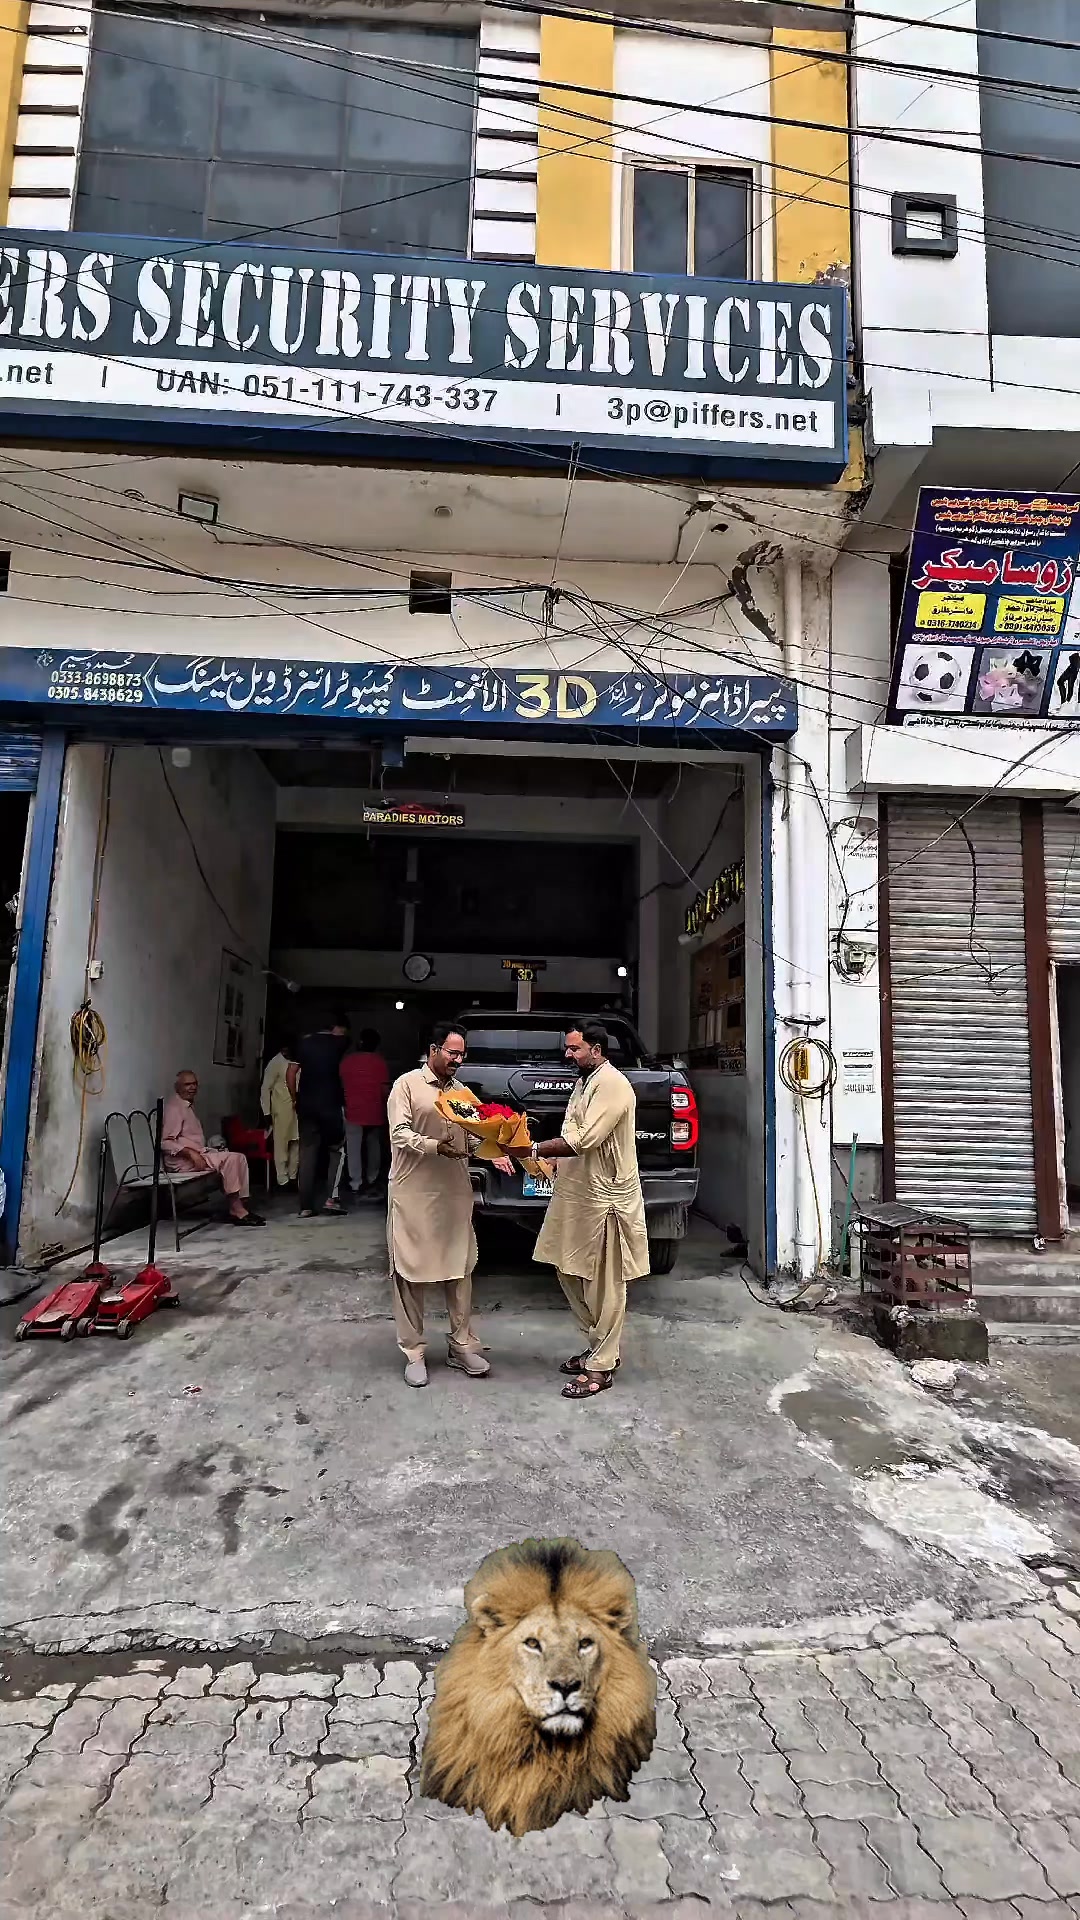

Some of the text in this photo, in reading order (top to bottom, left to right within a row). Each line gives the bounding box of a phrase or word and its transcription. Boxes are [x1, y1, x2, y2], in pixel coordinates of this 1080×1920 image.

[133, 256, 487, 364] SECURITY
[504, 280, 833, 389] SERVICES
[156, 369, 231, 395] UAN:
[244, 374, 498, 413] 051-111-743-337
[607, 397, 819, 433] 3p@piffers.net
[59, 651, 100, 672] وسیم
[92, 653, 136, 670] محمد
[226, 660, 277, 710] ویل
[515, 674, 598, 719] 3D
[363, 812, 464, 826] PARADIES MOTORS
[517, 968, 533, 981] 3D
